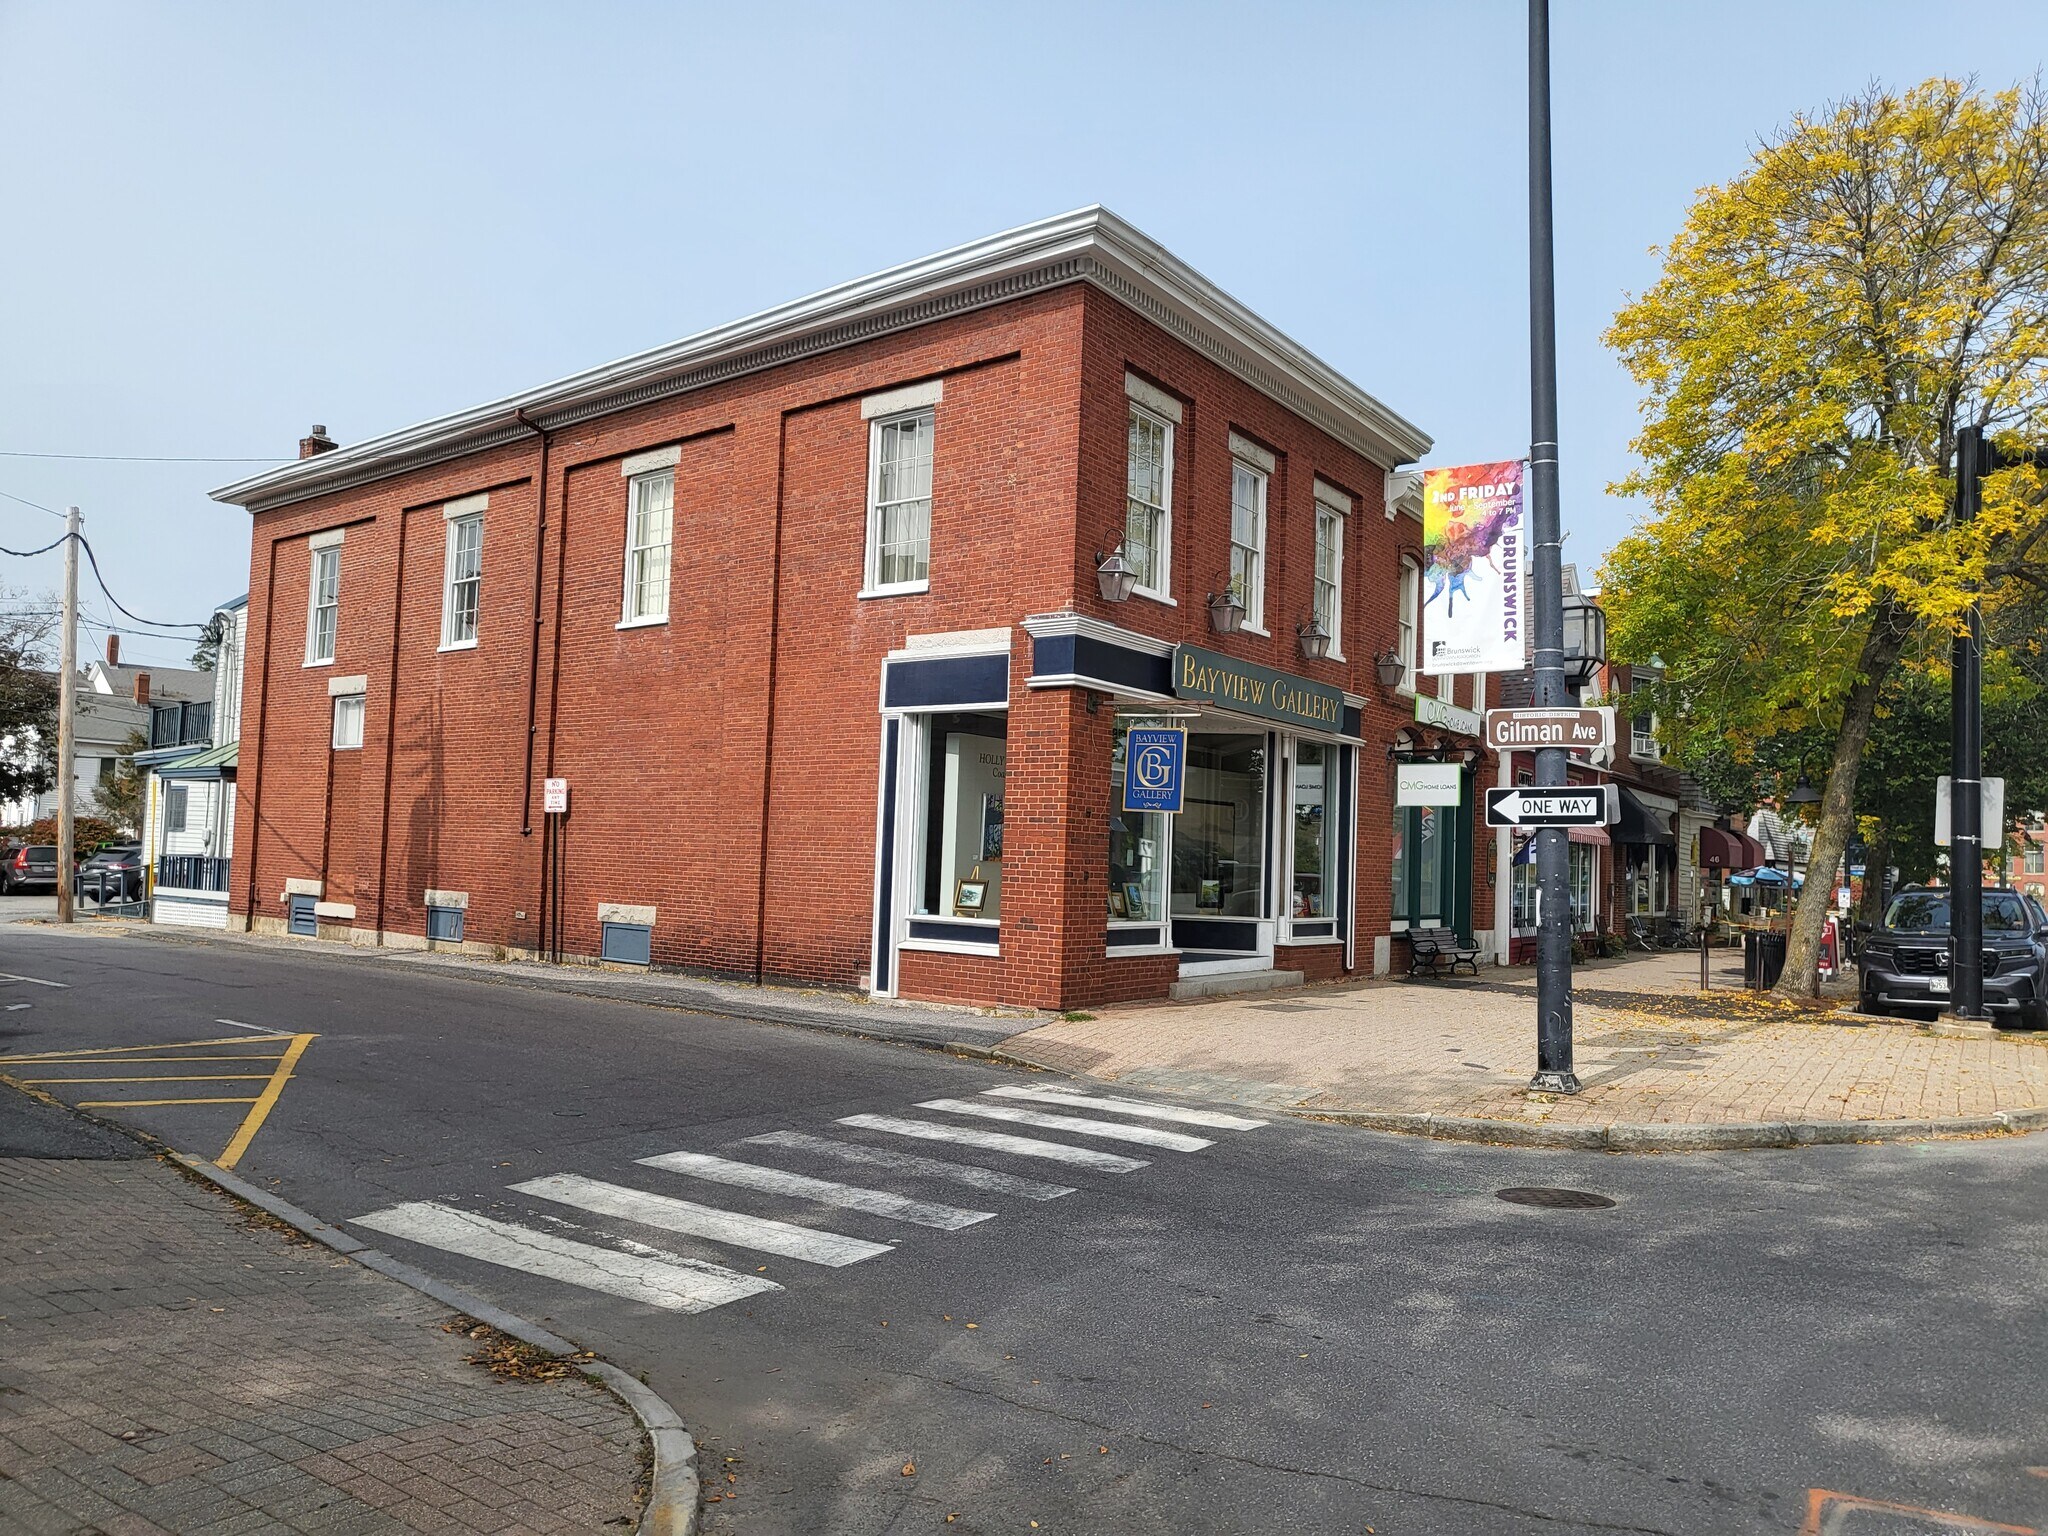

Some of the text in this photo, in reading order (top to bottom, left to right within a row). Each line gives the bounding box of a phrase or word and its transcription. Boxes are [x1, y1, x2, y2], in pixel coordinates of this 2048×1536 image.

[1432, 482, 1516, 503] 2ND FRIDAY
[1448, 504, 1466, 513] June
[1473, 498, 1516, 511] September
[1503, 535, 1517, 643] BRUNSWICK
[1447, 645, 1480, 655] Brunswick
[1182, 654, 1340, 723] BAYVIEW GALLERY
[1135, 733, 1177, 743] BAYVIEW
[1496, 721, 1597, 743] Gilman Ave
[979, 753, 1005, 765] HOLLY
[1400, 780, 1424, 790] CMG
[1132, 790, 1173, 800] GALLERY
[1522, 799, 1592, 814] ONE WAY
[1709, 855, 1720, 863] 46
